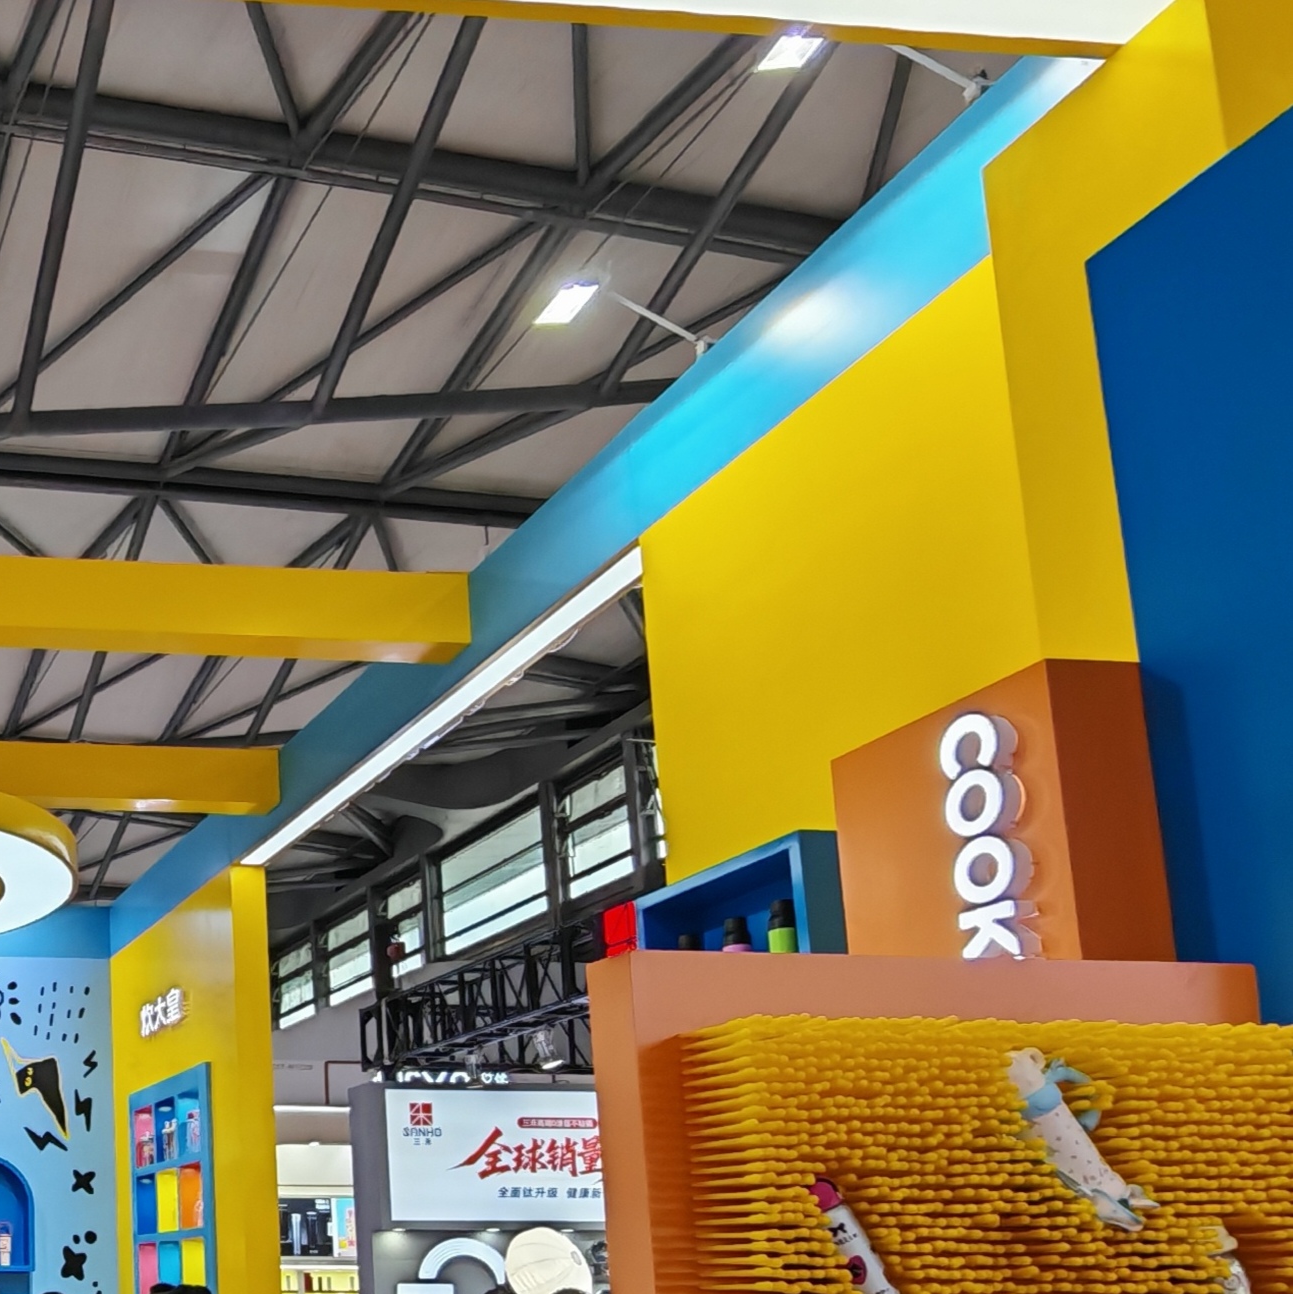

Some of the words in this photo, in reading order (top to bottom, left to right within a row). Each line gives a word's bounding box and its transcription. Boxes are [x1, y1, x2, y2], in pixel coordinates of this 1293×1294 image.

[939, 713, 1021, 959] COOK
[140, 987, 181, 1038] 炊大皇
[403, 1127, 443, 1138] SANHO
[446, 1126, 603, 1179] 全球销量
[498, 1186, 559, 1198] 全面钛升级
